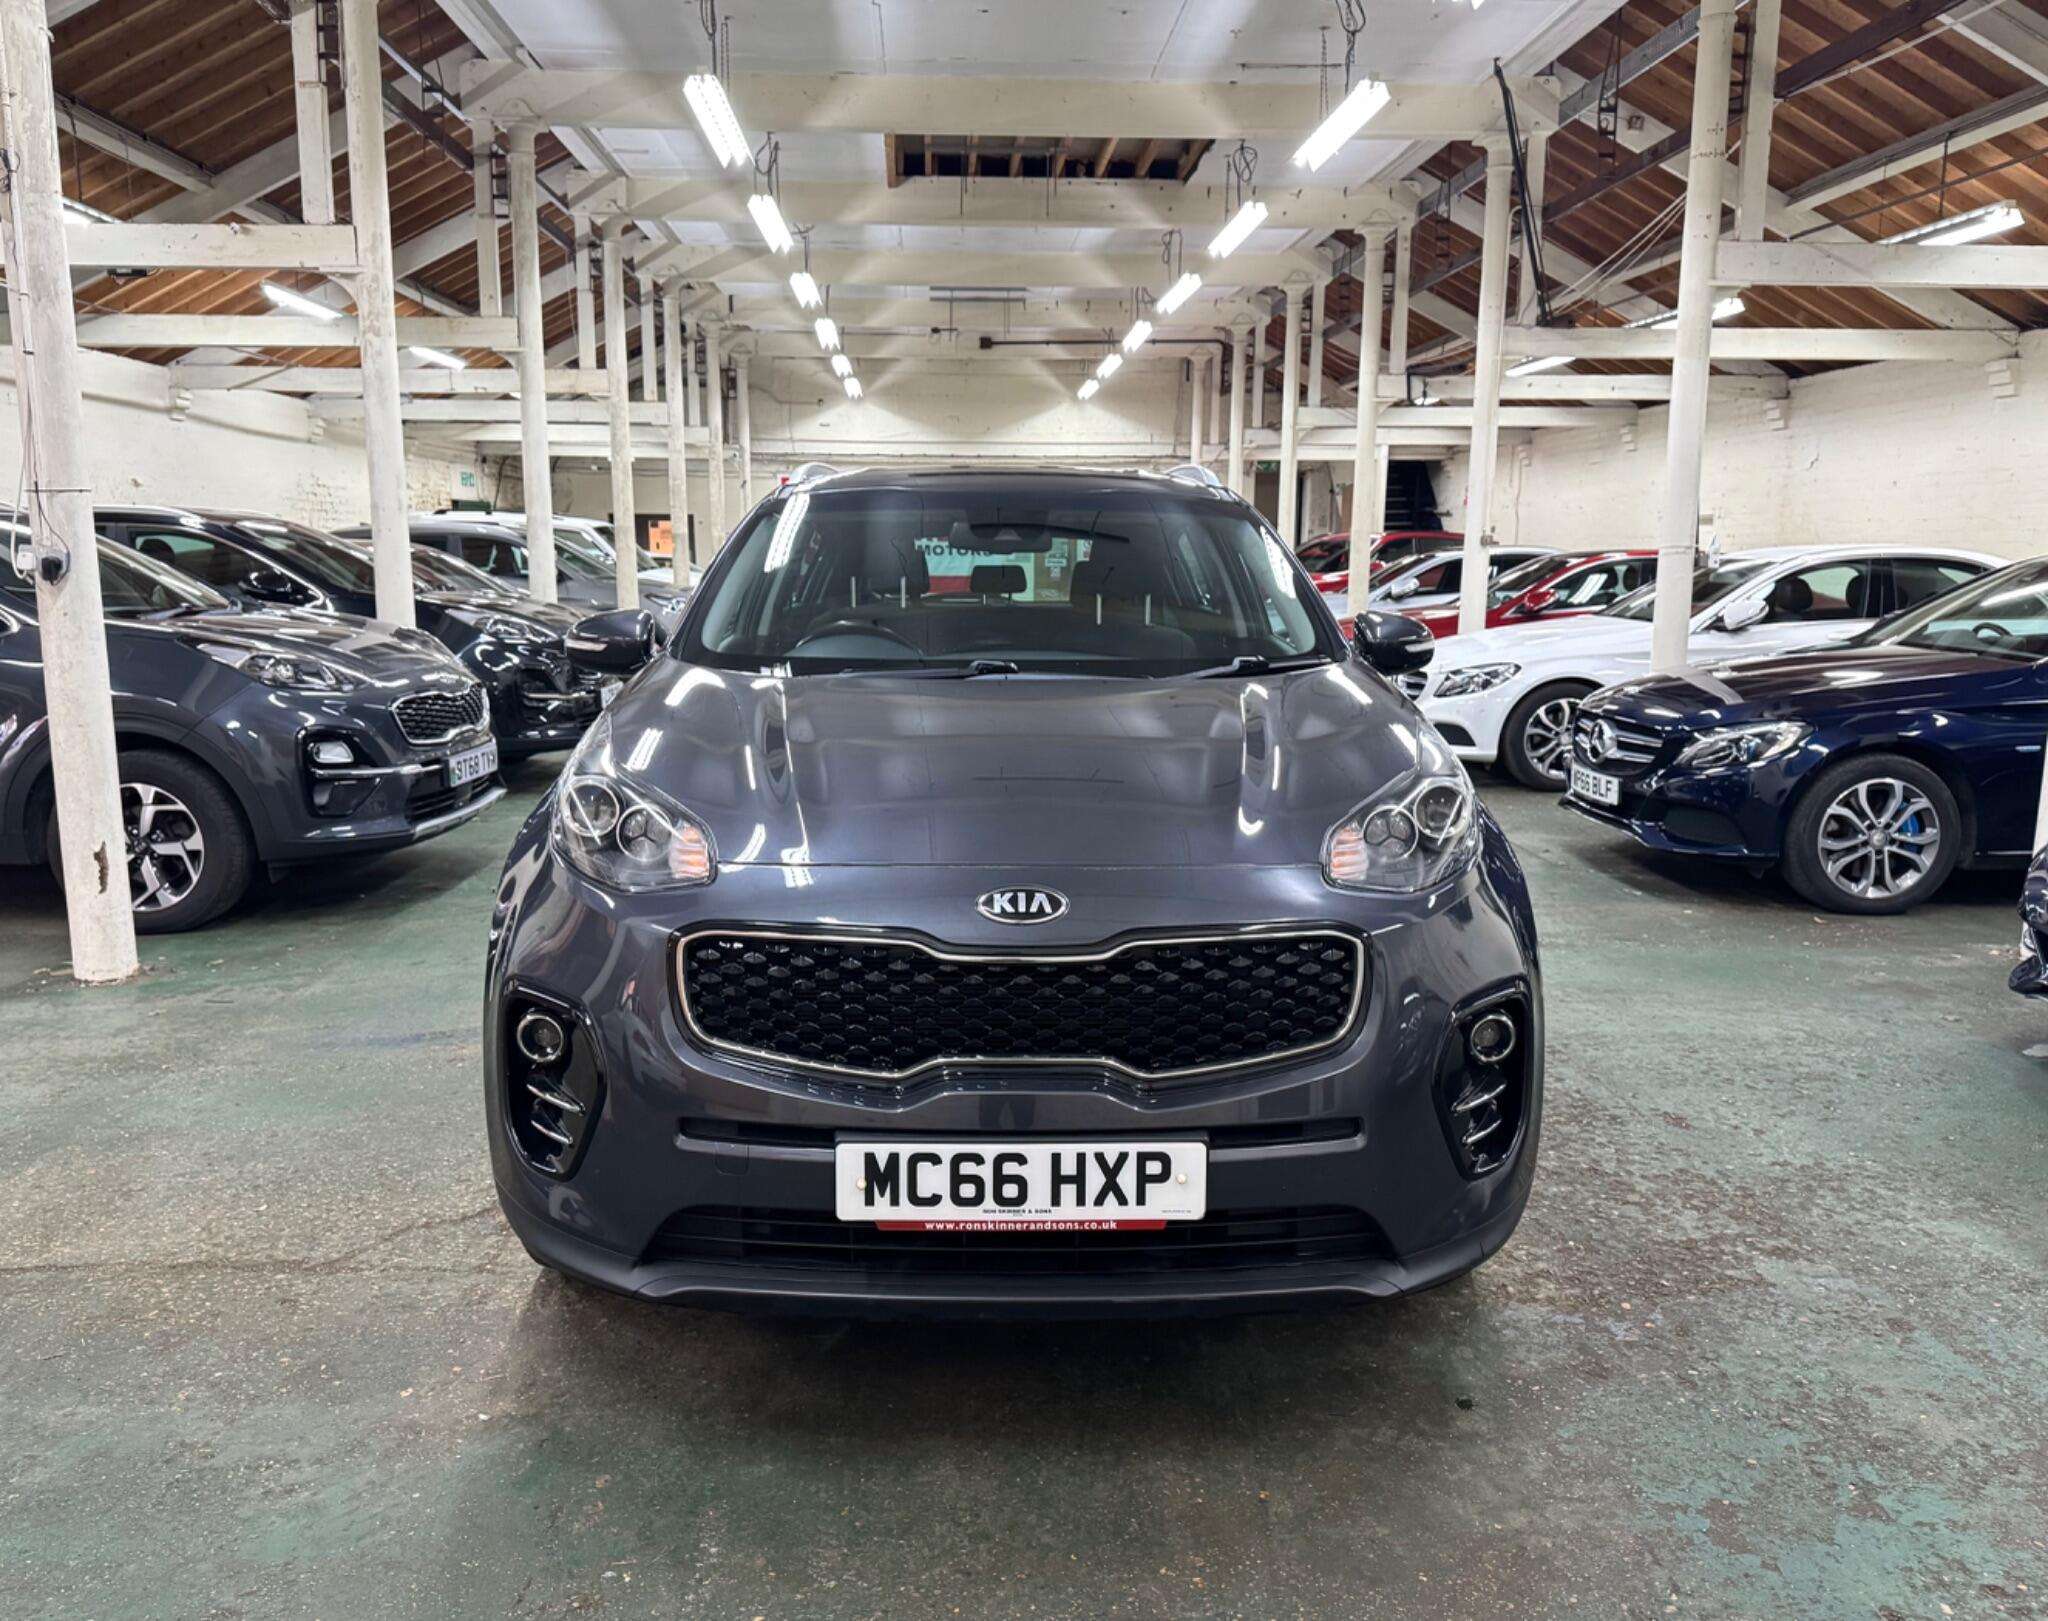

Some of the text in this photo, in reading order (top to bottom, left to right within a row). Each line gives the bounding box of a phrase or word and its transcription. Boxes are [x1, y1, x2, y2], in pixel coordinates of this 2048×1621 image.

[993, 892, 1053, 914] KIA
[864, 1151, 1172, 1207] MC66 HXP
[925, 1220, 1118, 1231] www.ronskinnerandsons.co.uk
